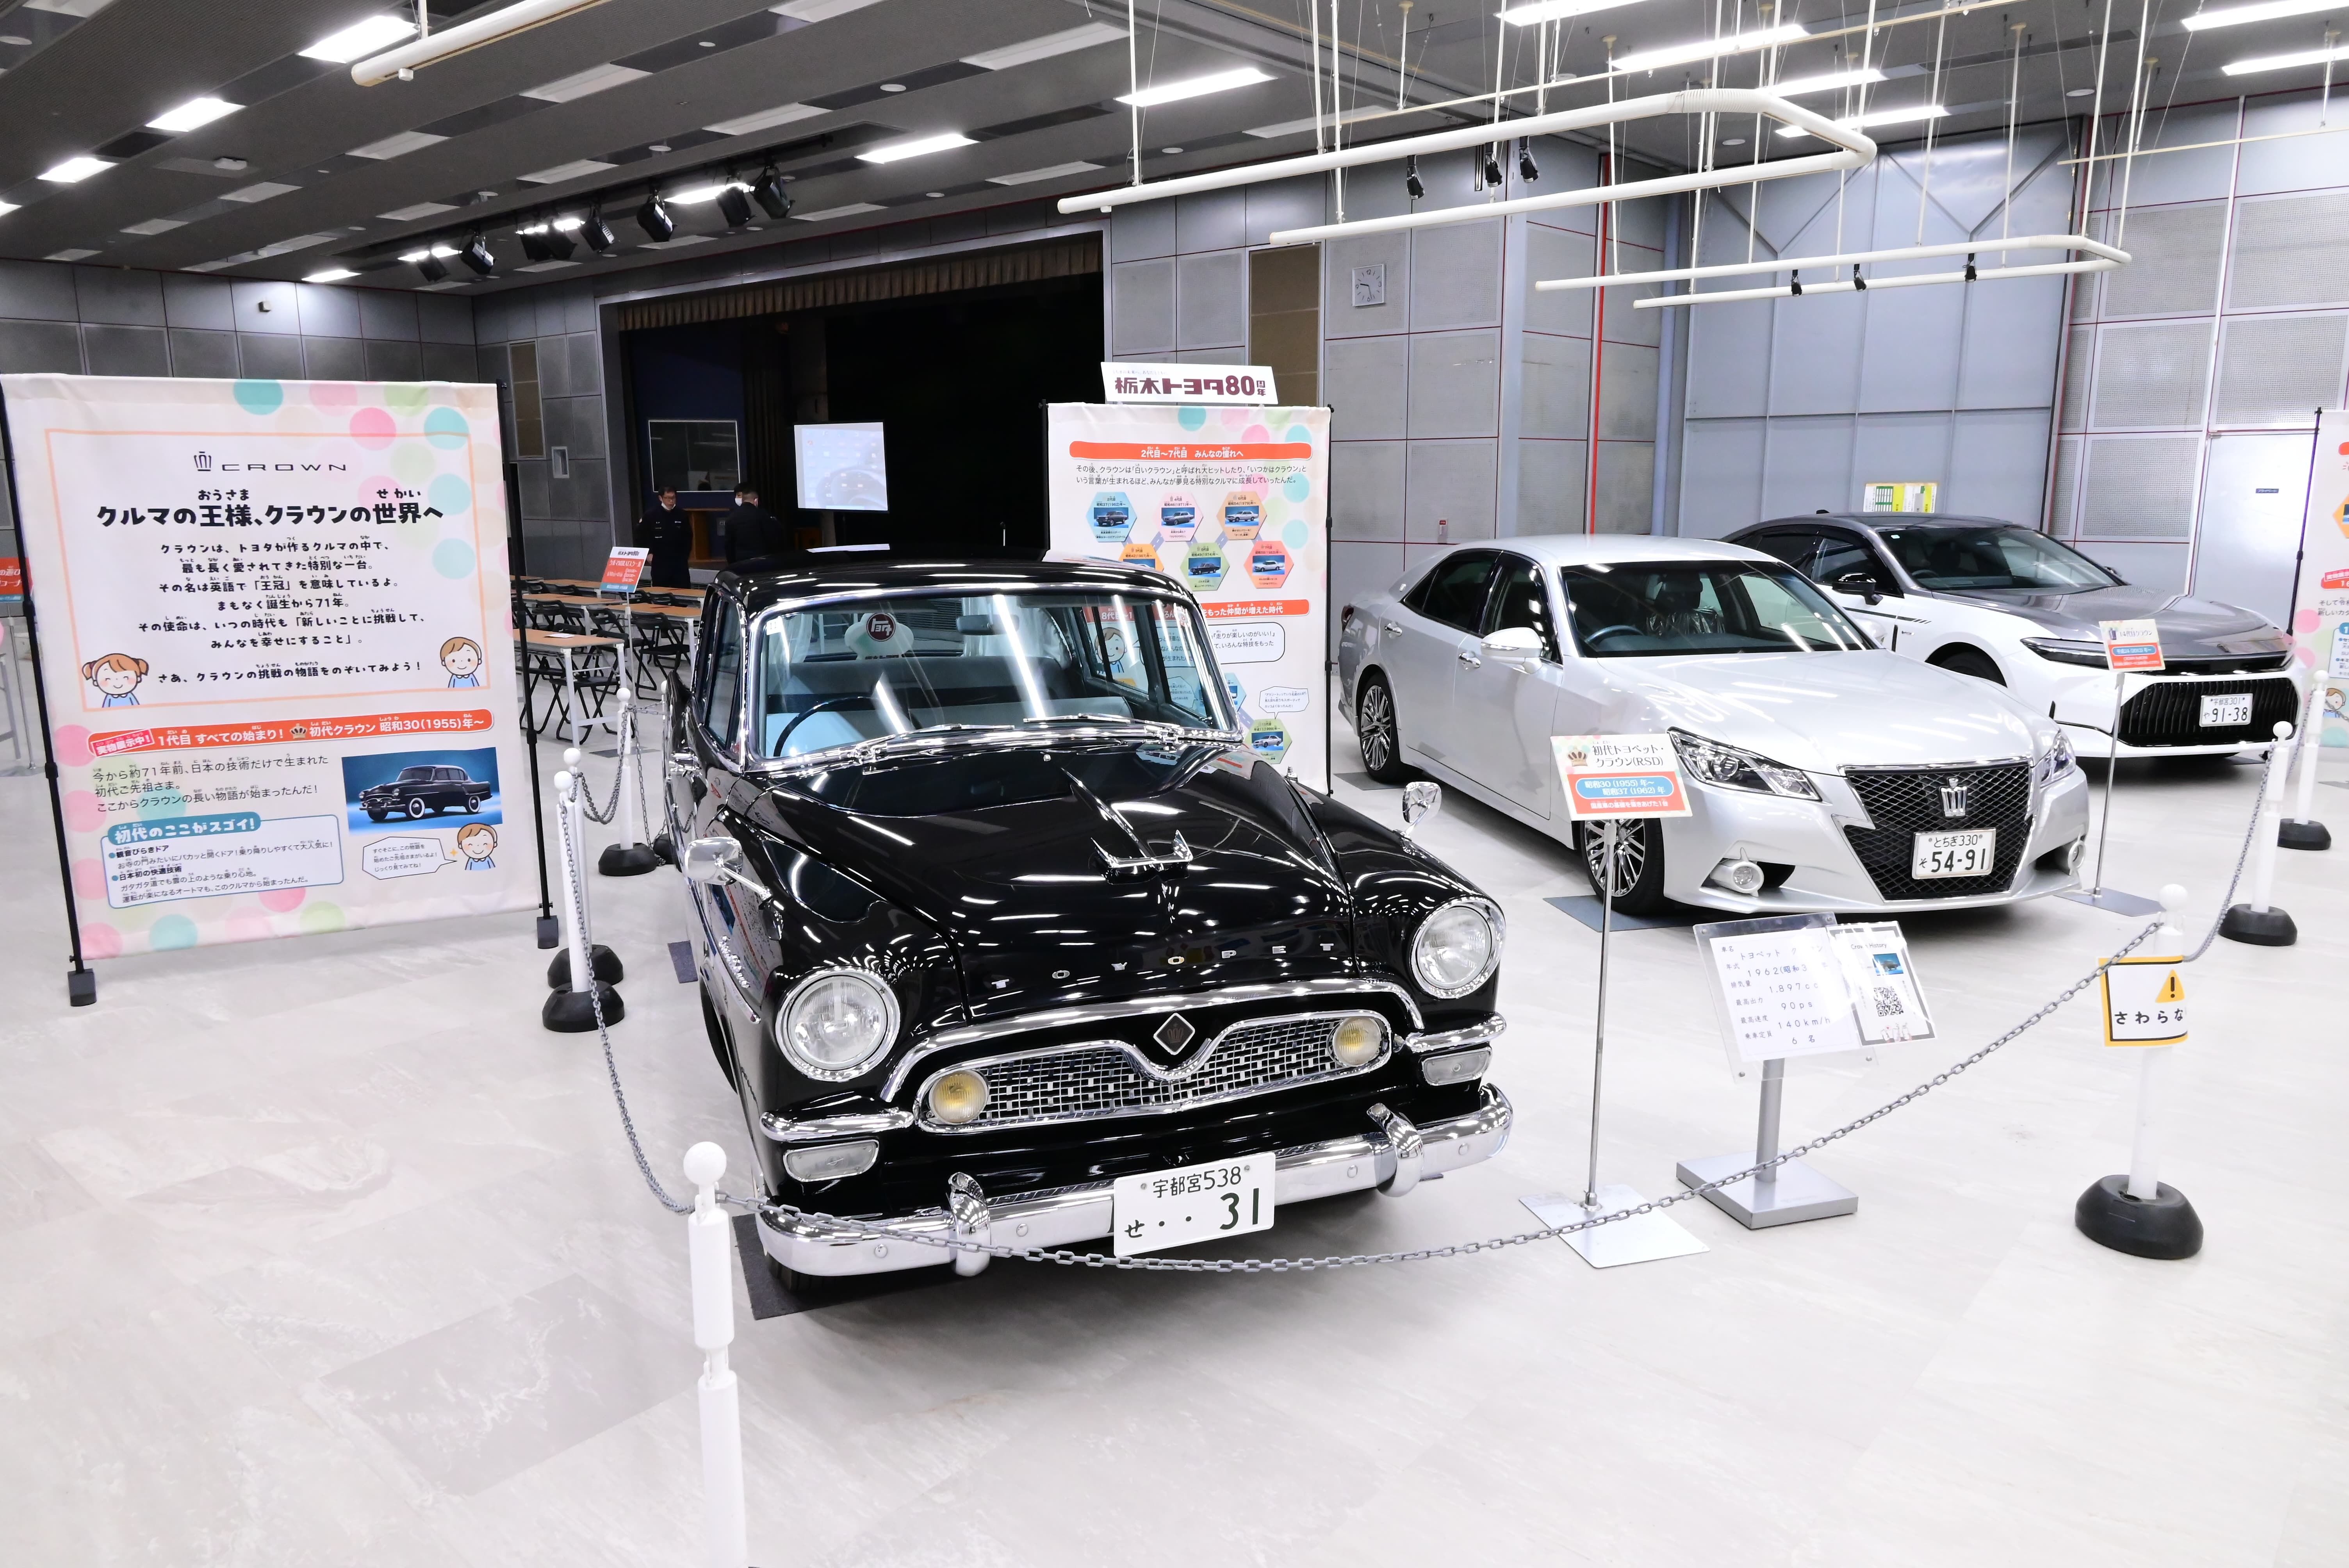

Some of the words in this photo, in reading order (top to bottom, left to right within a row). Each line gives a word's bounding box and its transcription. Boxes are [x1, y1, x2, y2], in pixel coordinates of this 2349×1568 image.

[1115, 375, 1266, 396] 栃木トヨタ80周年
[1141, 449, 1187, 458] 2代目～7代目
[1194, 449, 1244, 458] みんなの憧れへ
[198, 489, 250, 501] おうさま
[376, 488, 421, 499] せかい
[97, 502, 444, 527] クルマの王様、クラウンの世界へ
[160, 541, 389, 554] クラウンは、トヨタが作るクルマの中で、
[182, 560, 372, 574] 最も長く愛されてきた特別な一台。
[159, 578, 398, 593] その名は英語で「王冠」を意味しているよ。
[217, 597, 349, 611] まもなく誕生から71年。
[210, 634, 362, 649] みんなを幸せにすること」。
[158, 662, 421, 683] さあ、クラウンの挑戦の物語をのぞいてみよう！
[2214, 697, 2240, 706] 宇都宮301
[2211, 707, 2248, 722] 91-38
[309, 723, 376, 738] 初代クラウン
[380, 717, 485, 732] 昭和30(1955)年～
[158, 734, 191, 746] 1代目
[194, 730, 284, 744] すべての始まり！
[93, 755, 329, 782] 今から約71年前、日本の技術だけで生まれた
[1596, 756, 1663, 768] クラウン(RSD)
[94, 780, 182, 798] 初代ご先祖さま。
[97, 784, 317, 813] ここからクラウンの長い物語が始まったんだ！
[114, 818, 255, 845] 初代のここがスゴイ！
[1934, 834, 1978, 848] とちぎ330
[1919, 857, 1927, 868] そ
[1931, 848, 1986, 873] 54-91
[993, 943, 1334, 989] TOYOPET
[1153, 1165, 1241, 1198] 宇都宮538
[1125, 1219, 1145, 1238] せ
